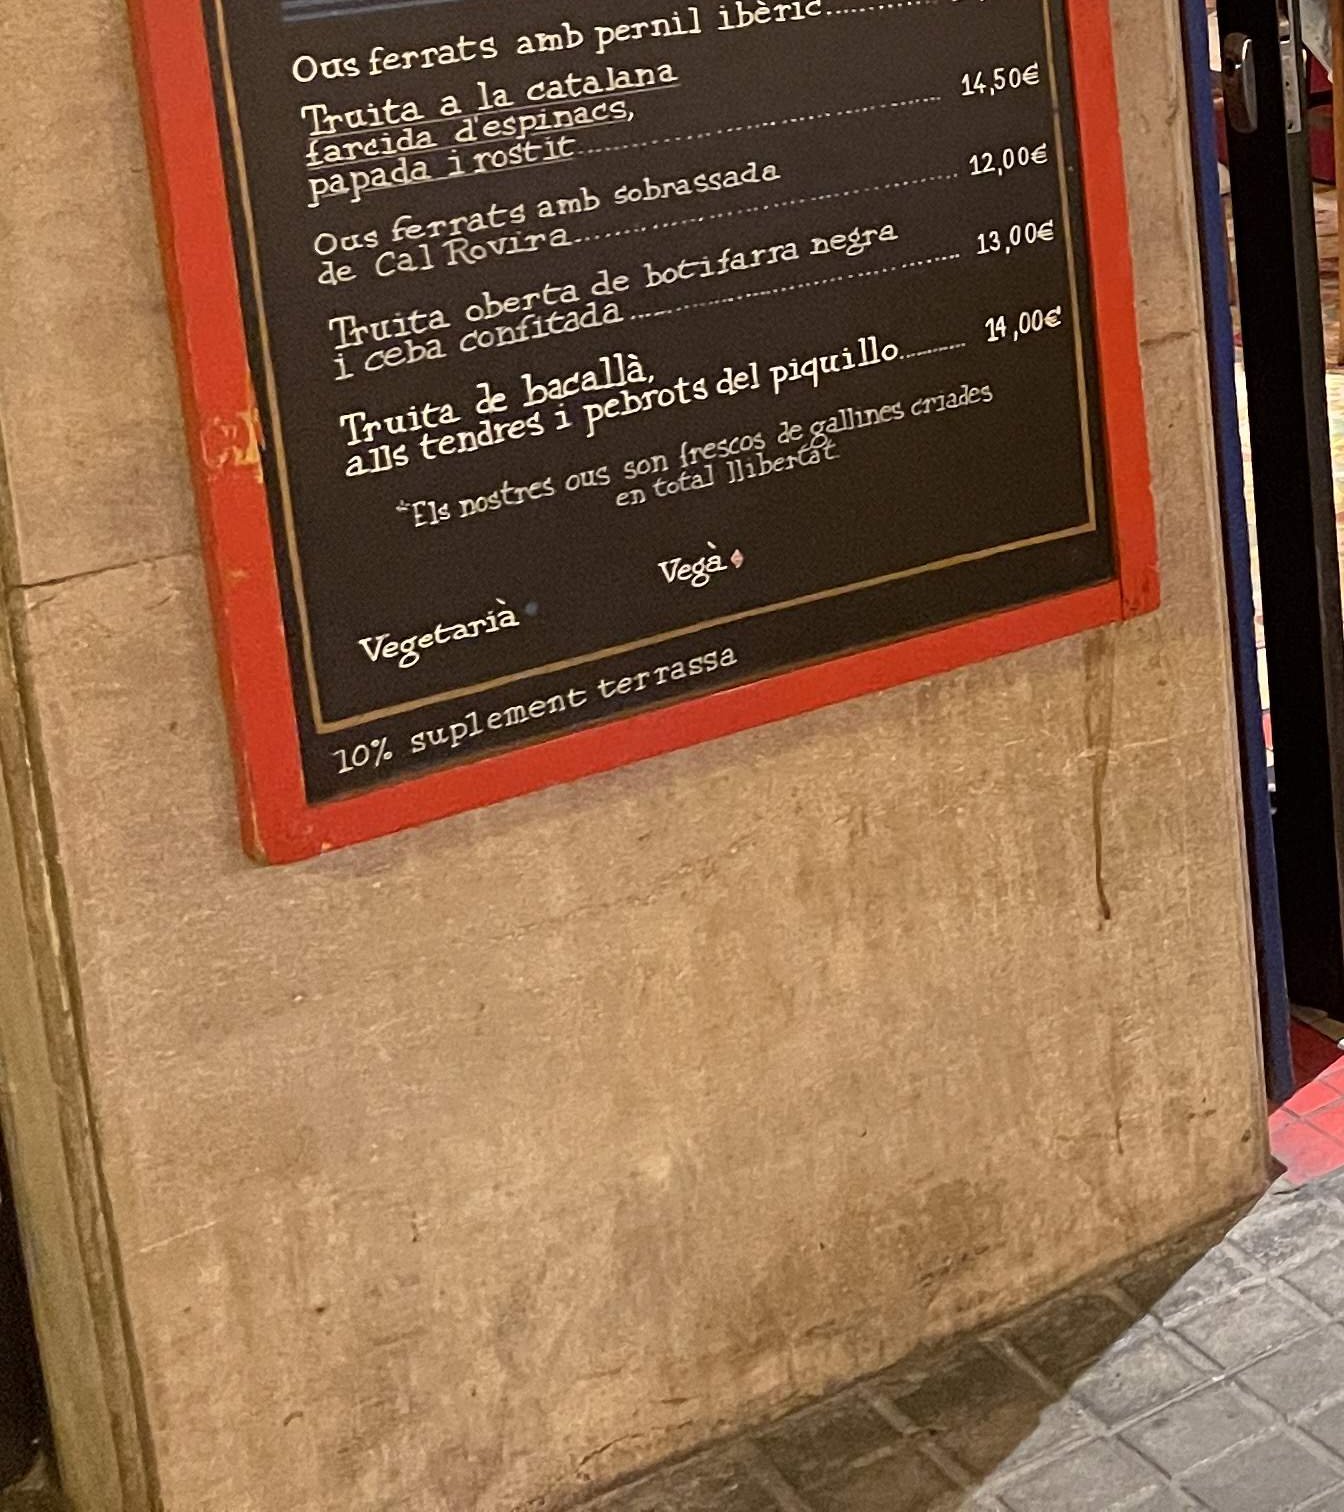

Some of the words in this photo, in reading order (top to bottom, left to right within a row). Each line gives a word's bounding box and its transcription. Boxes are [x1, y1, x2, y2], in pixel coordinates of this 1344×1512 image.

[370, 36, 497, 75] ferrats
[595, 7, 701, 54] pernil
[719, 0, 821, 30] ibèric
[301, 99, 424, 136] Truita
[527, 64, 677, 100] catalana
[306, 128, 437, 166] farcida
[455, 101, 633, 142] d'espinacs,
[308, 157, 432, 208] papada
[474, 137, 574, 173] rostit
[962, 63, 1038, 95] 14,50€
[392, 204, 525, 241] ferrats
[615, 162, 780, 204] sobrassada
[443, 229, 572, 265] Rovira
[970, 144, 1046, 175] 12,00€
[329, 310, 450, 349] Truita
[466, 284, 579, 321] oberta
[644, 243, 798, 287] botifarra
[811, 225, 897, 256] negra
[460, 302, 623, 352] confitada
[978, 220, 1053, 254] 13,00€
[340, 404, 460, 445] Truita
[420, 412, 544, 459] tendres
[583, 378, 708, 437] pebrots
[770, 336, 898, 394] piquillo
[986, 306, 1061, 342] 14,00€
[459, 478, 554, 517] nostres
[809, 403, 904, 449] gallines
[658, 542, 727, 587] Vegà
[359, 599, 519, 668] Vegetarià
[335, 738, 392, 773] 10%
[411, 690, 586, 752] suplement
[598, 648, 736, 697] terrassa
